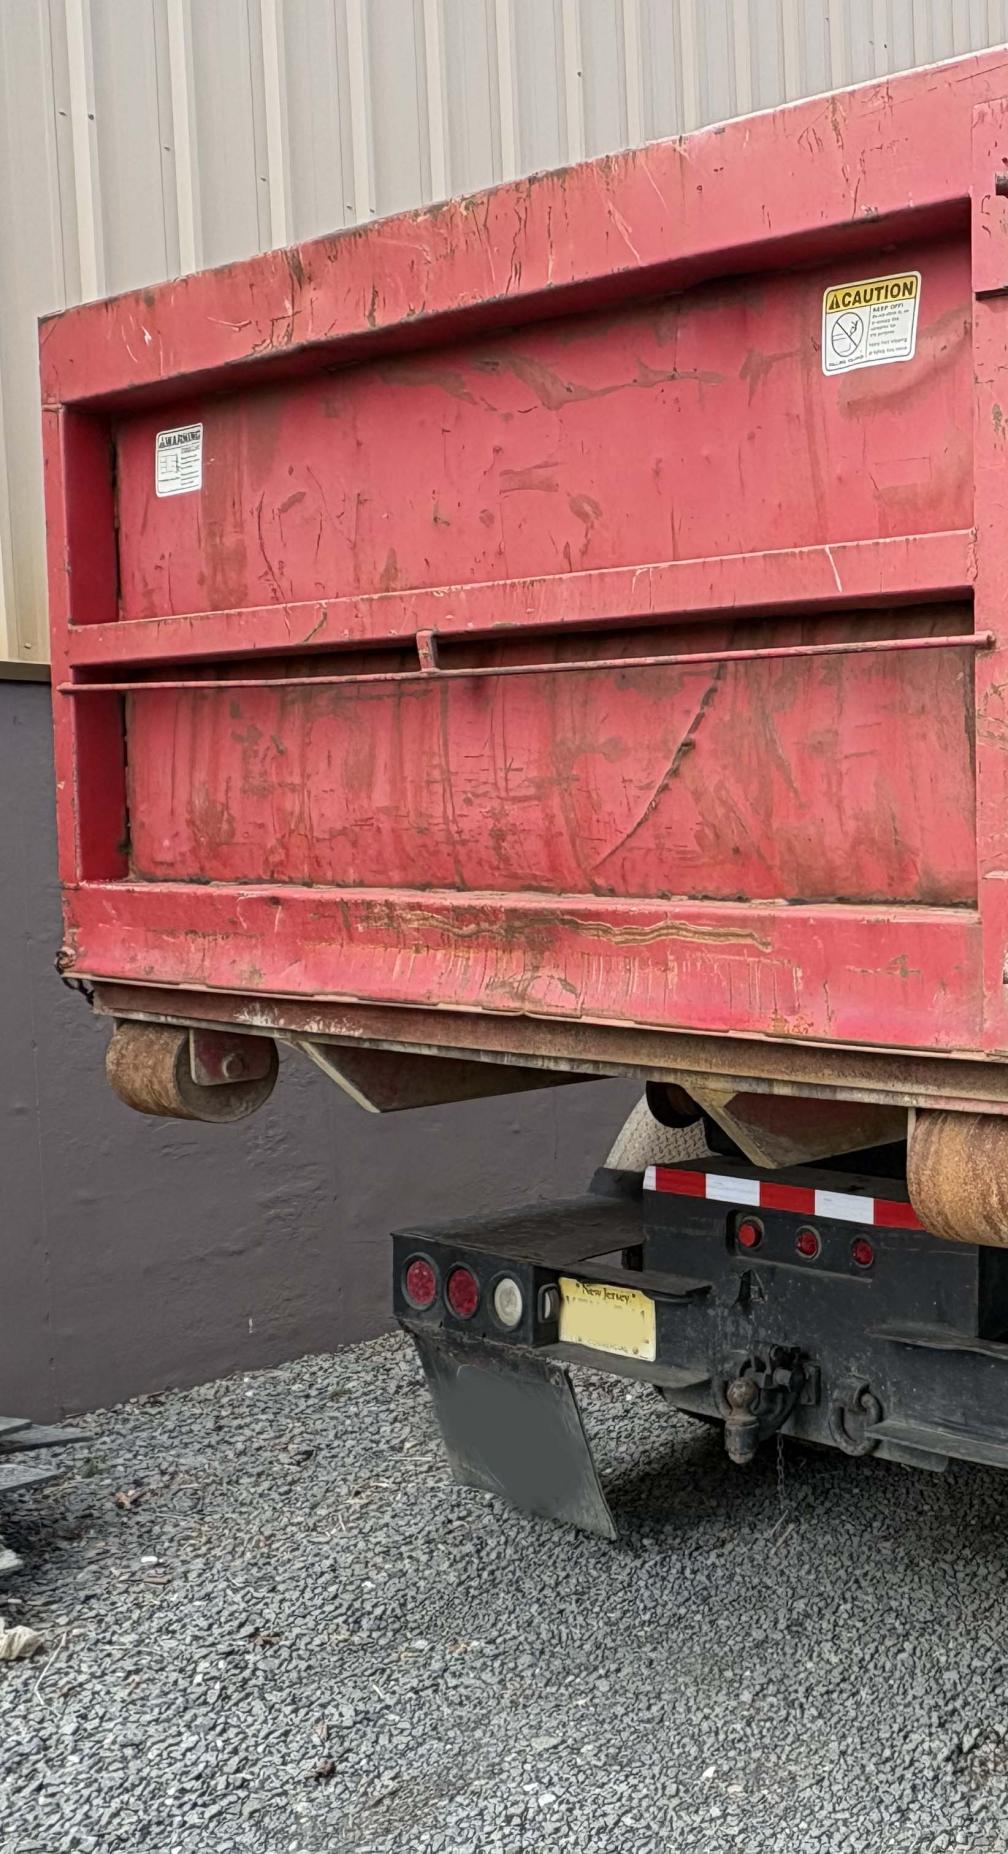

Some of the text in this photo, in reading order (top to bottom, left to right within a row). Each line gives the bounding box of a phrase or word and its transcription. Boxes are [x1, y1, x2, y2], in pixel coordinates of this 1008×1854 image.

[841, 281, 914, 307] CAUTION
[582, 1284, 630, 1303] New Jersey
